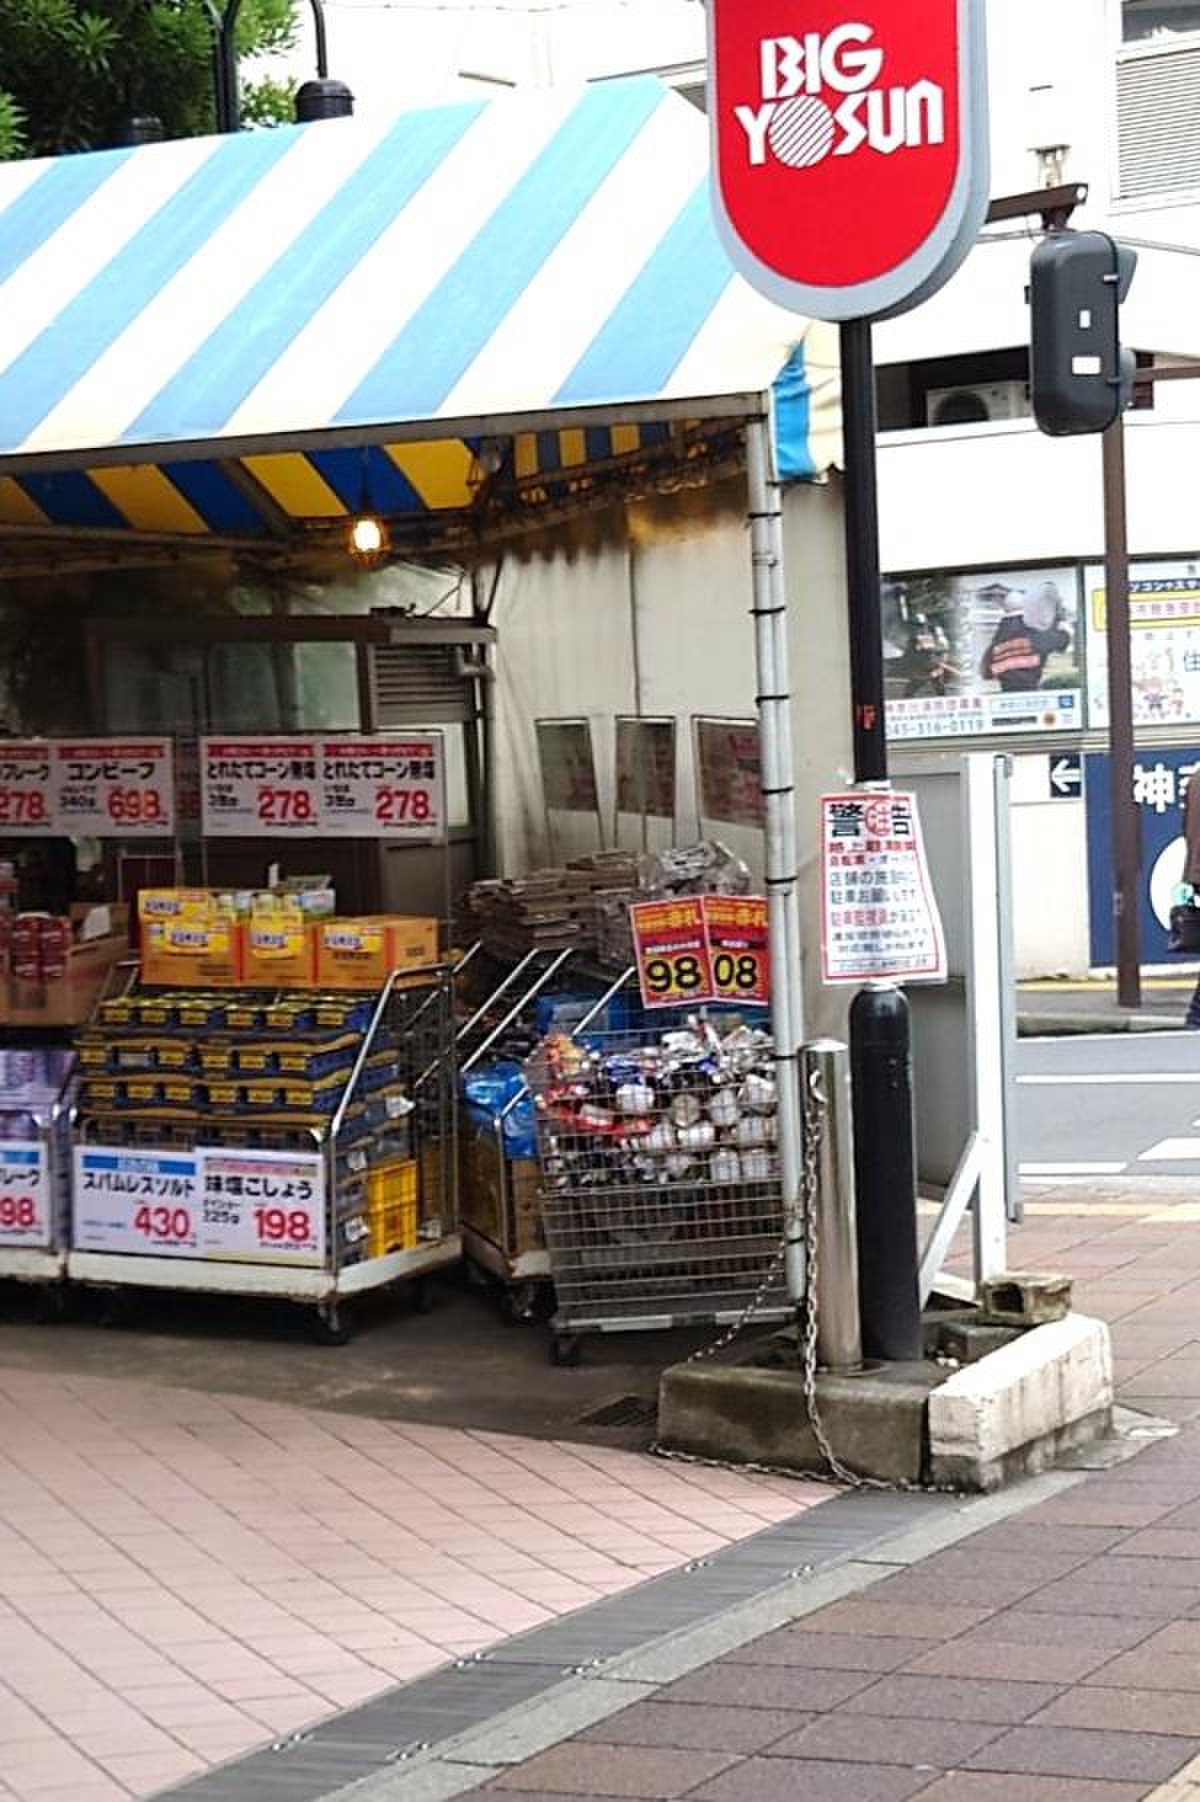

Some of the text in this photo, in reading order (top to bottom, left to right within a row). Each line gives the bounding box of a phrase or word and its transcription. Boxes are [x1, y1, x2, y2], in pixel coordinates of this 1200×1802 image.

[760, 22, 884, 99] BIG
[734, 78, 946, 169] YOSUN
[67, 762, 155, 781] コンビーフ
[258, 790, 311, 820] 278
[375, 790, 431, 820] 278
[645, 955, 703, 993] 98
[83, 1172, 197, 1198] スパムレスソルト
[204, 1175, 313, 1200] 味塩こしょう
[135, 1206, 191, 1239] 430
[253, 1209, 310, 1242] 198
